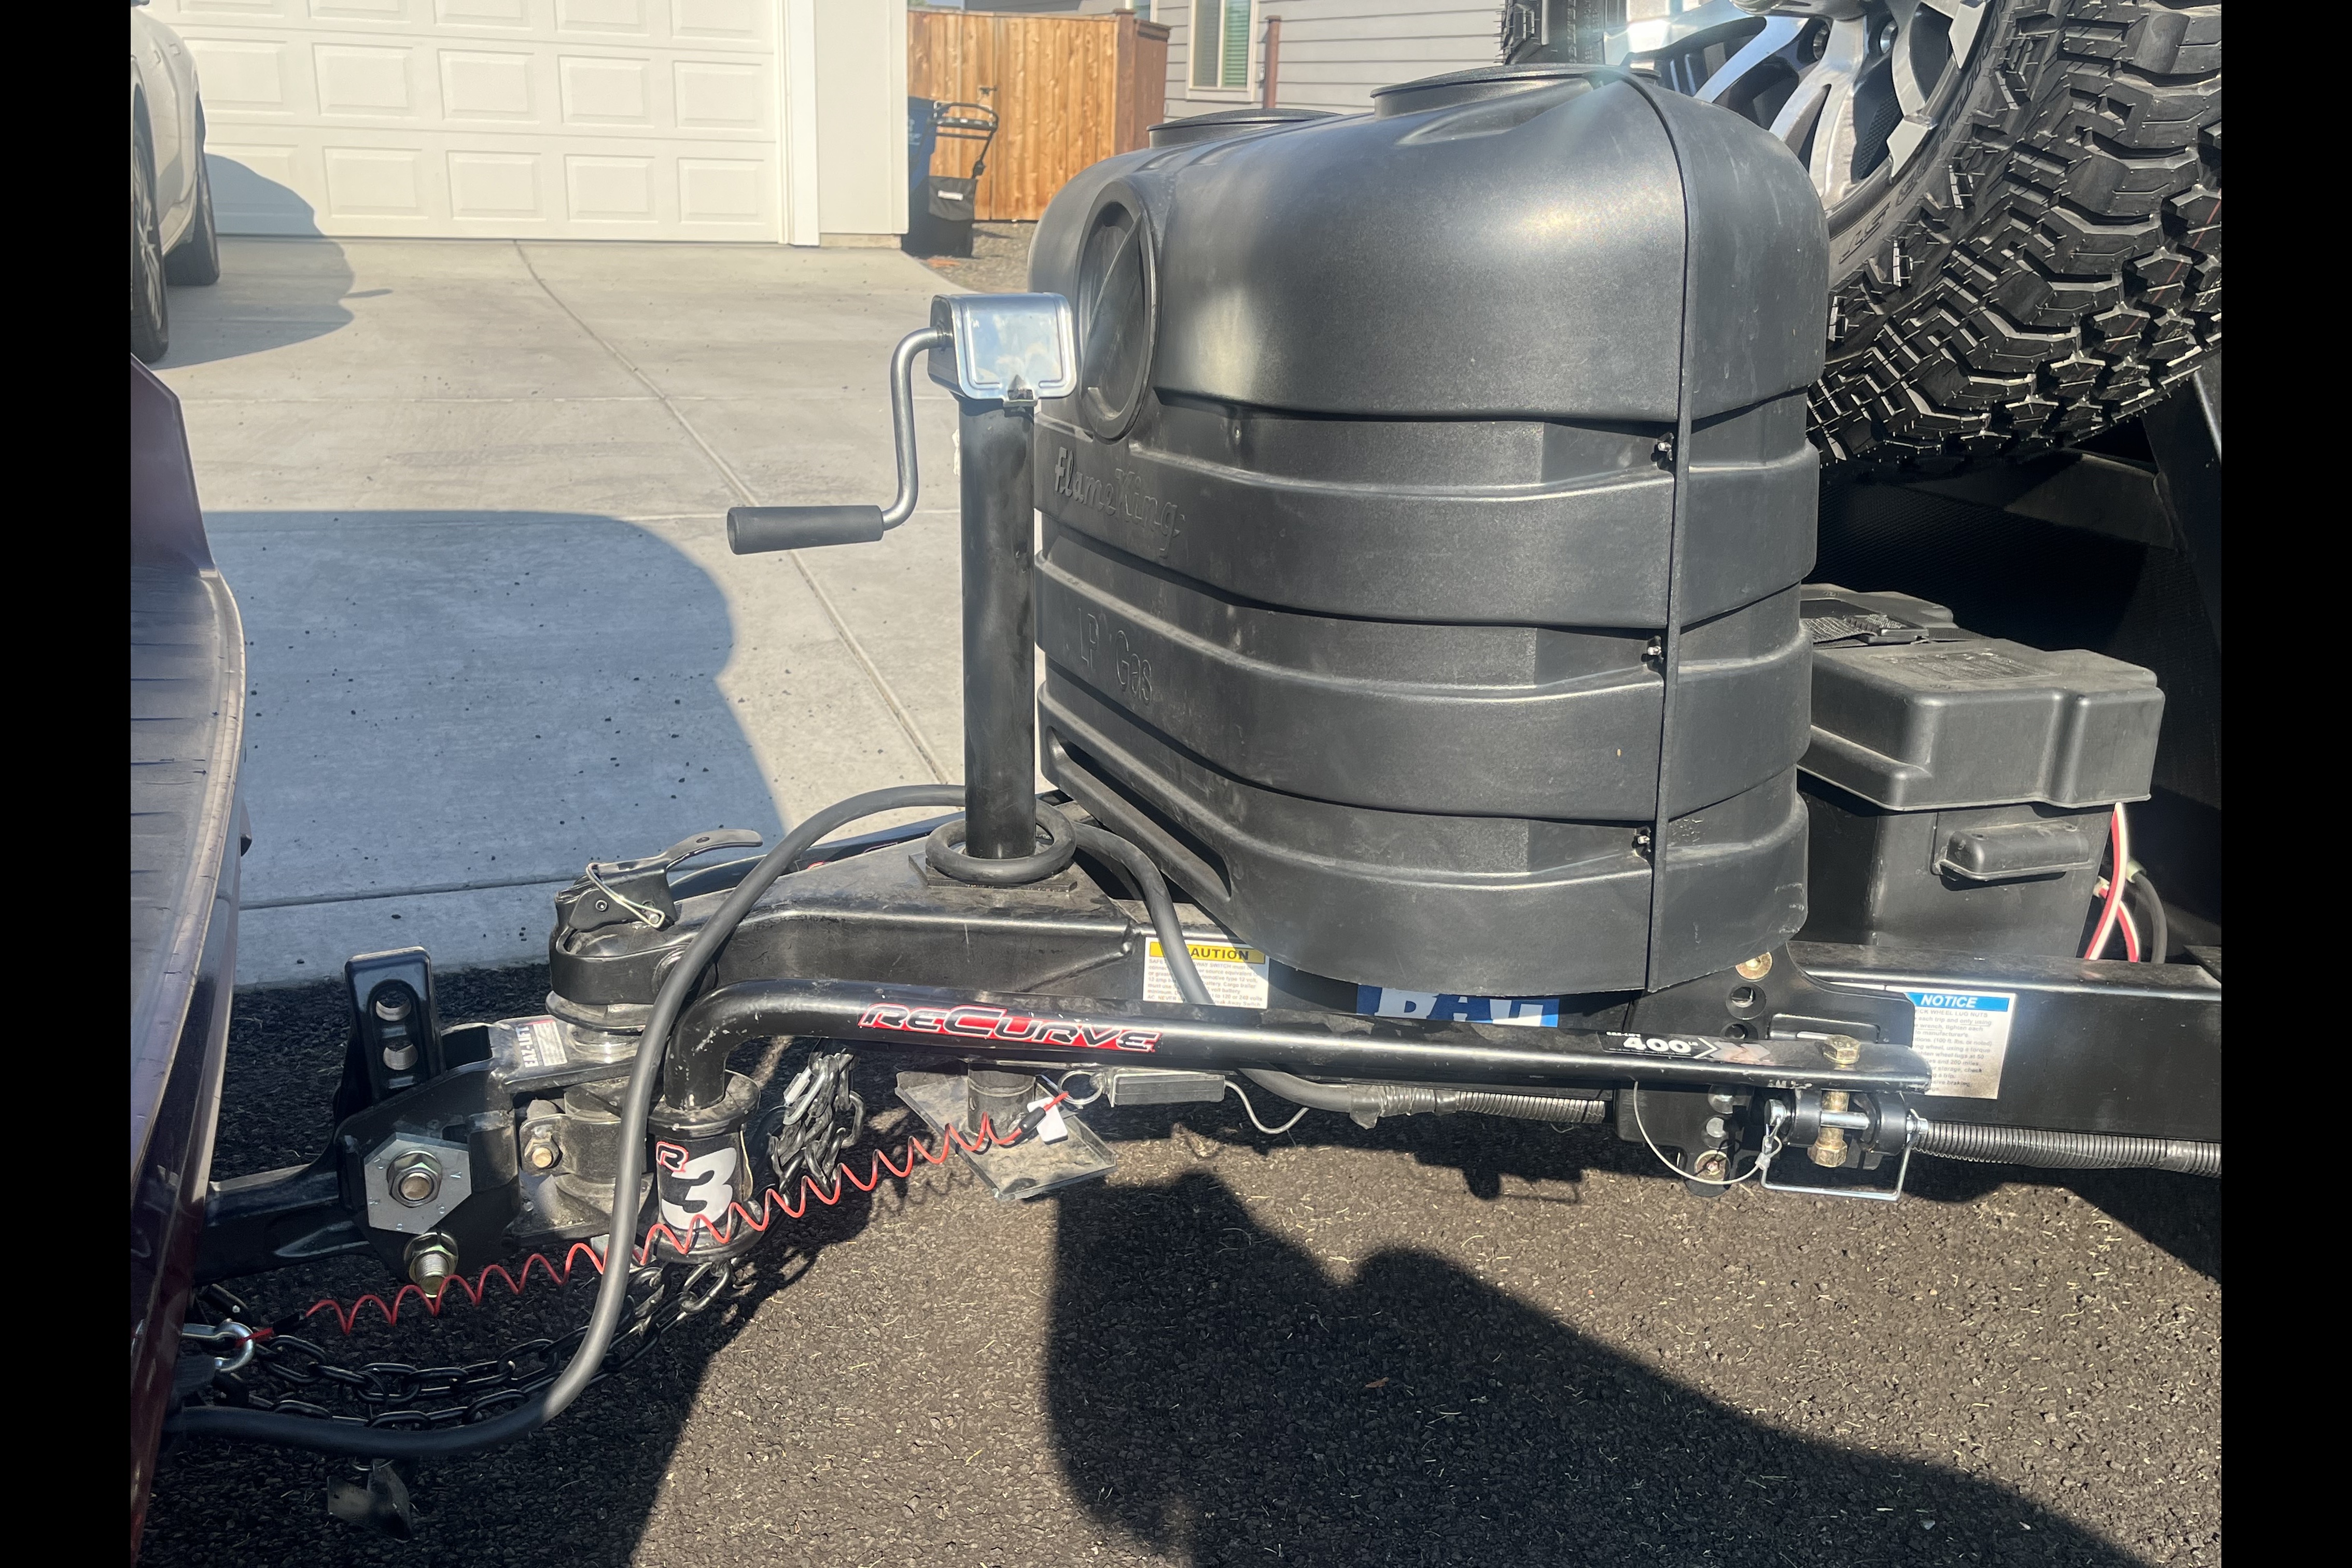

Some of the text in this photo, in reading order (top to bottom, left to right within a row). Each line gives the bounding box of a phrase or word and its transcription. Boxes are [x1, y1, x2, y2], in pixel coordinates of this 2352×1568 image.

[1077, 608, 1153, 706] LP Gas
[1189, 947, 1249, 960] AUTION
[1921, 994, 1978, 1008] NOTICE
[515, 1026, 539, 1068] EAZ-LIFT
[1623, 1037, 1691, 1053] 400
